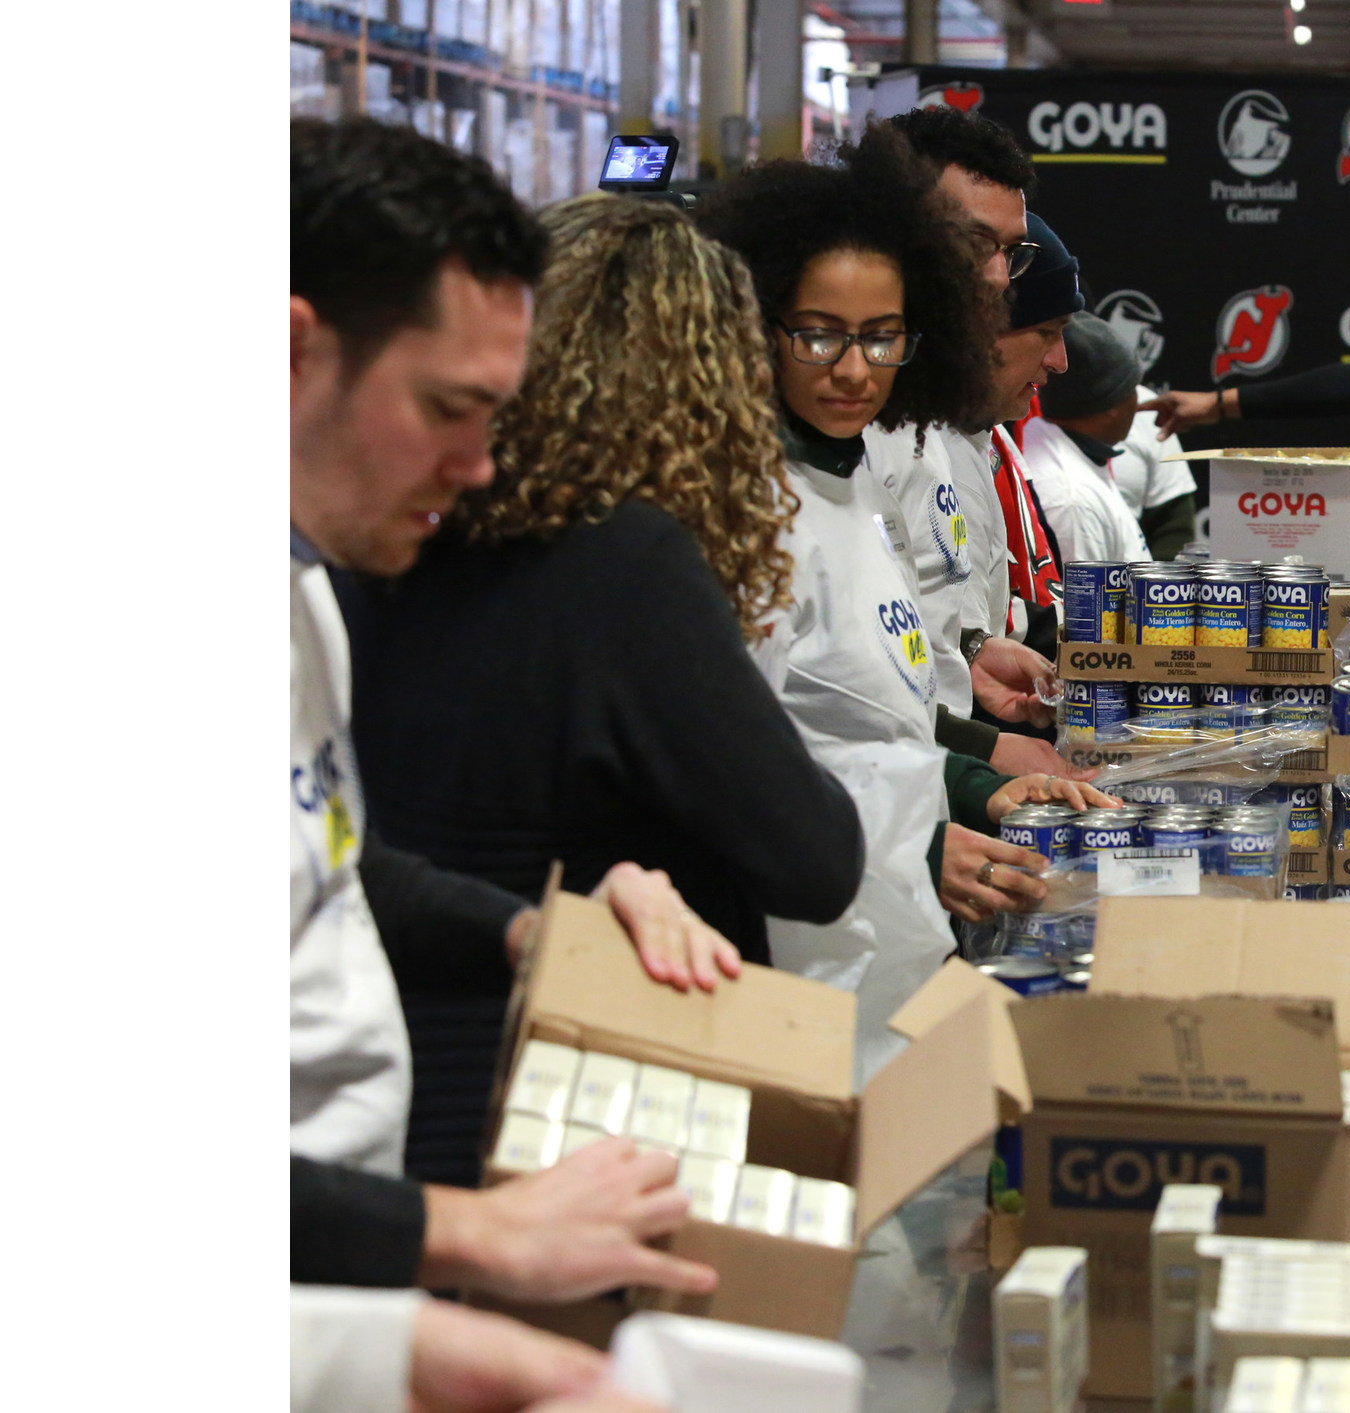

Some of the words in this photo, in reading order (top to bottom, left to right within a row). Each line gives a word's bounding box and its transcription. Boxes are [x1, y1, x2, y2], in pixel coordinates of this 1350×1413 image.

[1028, 102, 1167, 151] GOYA
[1210, 180, 1297, 200] Prudential
[1227, 204, 1281, 223] Center
[1238, 491, 1327, 518] GOYA
[1109, 569, 1128, 588] GO
[1148, 584, 1196, 603] GOYA
[1199, 584, 1242, 603] OYA
[1265, 584, 1306, 603] OYA
[1164, 609, 1185, 617] Golden
[1165, 616, 1185, 625] Tierno
[1219, 618, 1241, 626] Entero
[1220, 610, 1237, 618] Corn
[1285, 611, 1305, 619] Corn
[1284, 618, 1306, 627] Entero
[1070, 651, 1132, 671] GOYA
[1171, 650, 1196, 661] 2556
[1065, 683, 1088, 701] YA
[1138, 684, 1191, 703] GOYA
[1204, 685, 1228, 703] YA
[1272, 687, 1326, 705] GOYA
[1292, 787, 1319, 807] GO
[1001, 826, 1033, 844] OYA
[1084, 831, 1131, 847] GOYA
[1230, 836, 1274, 852] GOYA
[1057, 1145, 1243, 1200] GOYA
